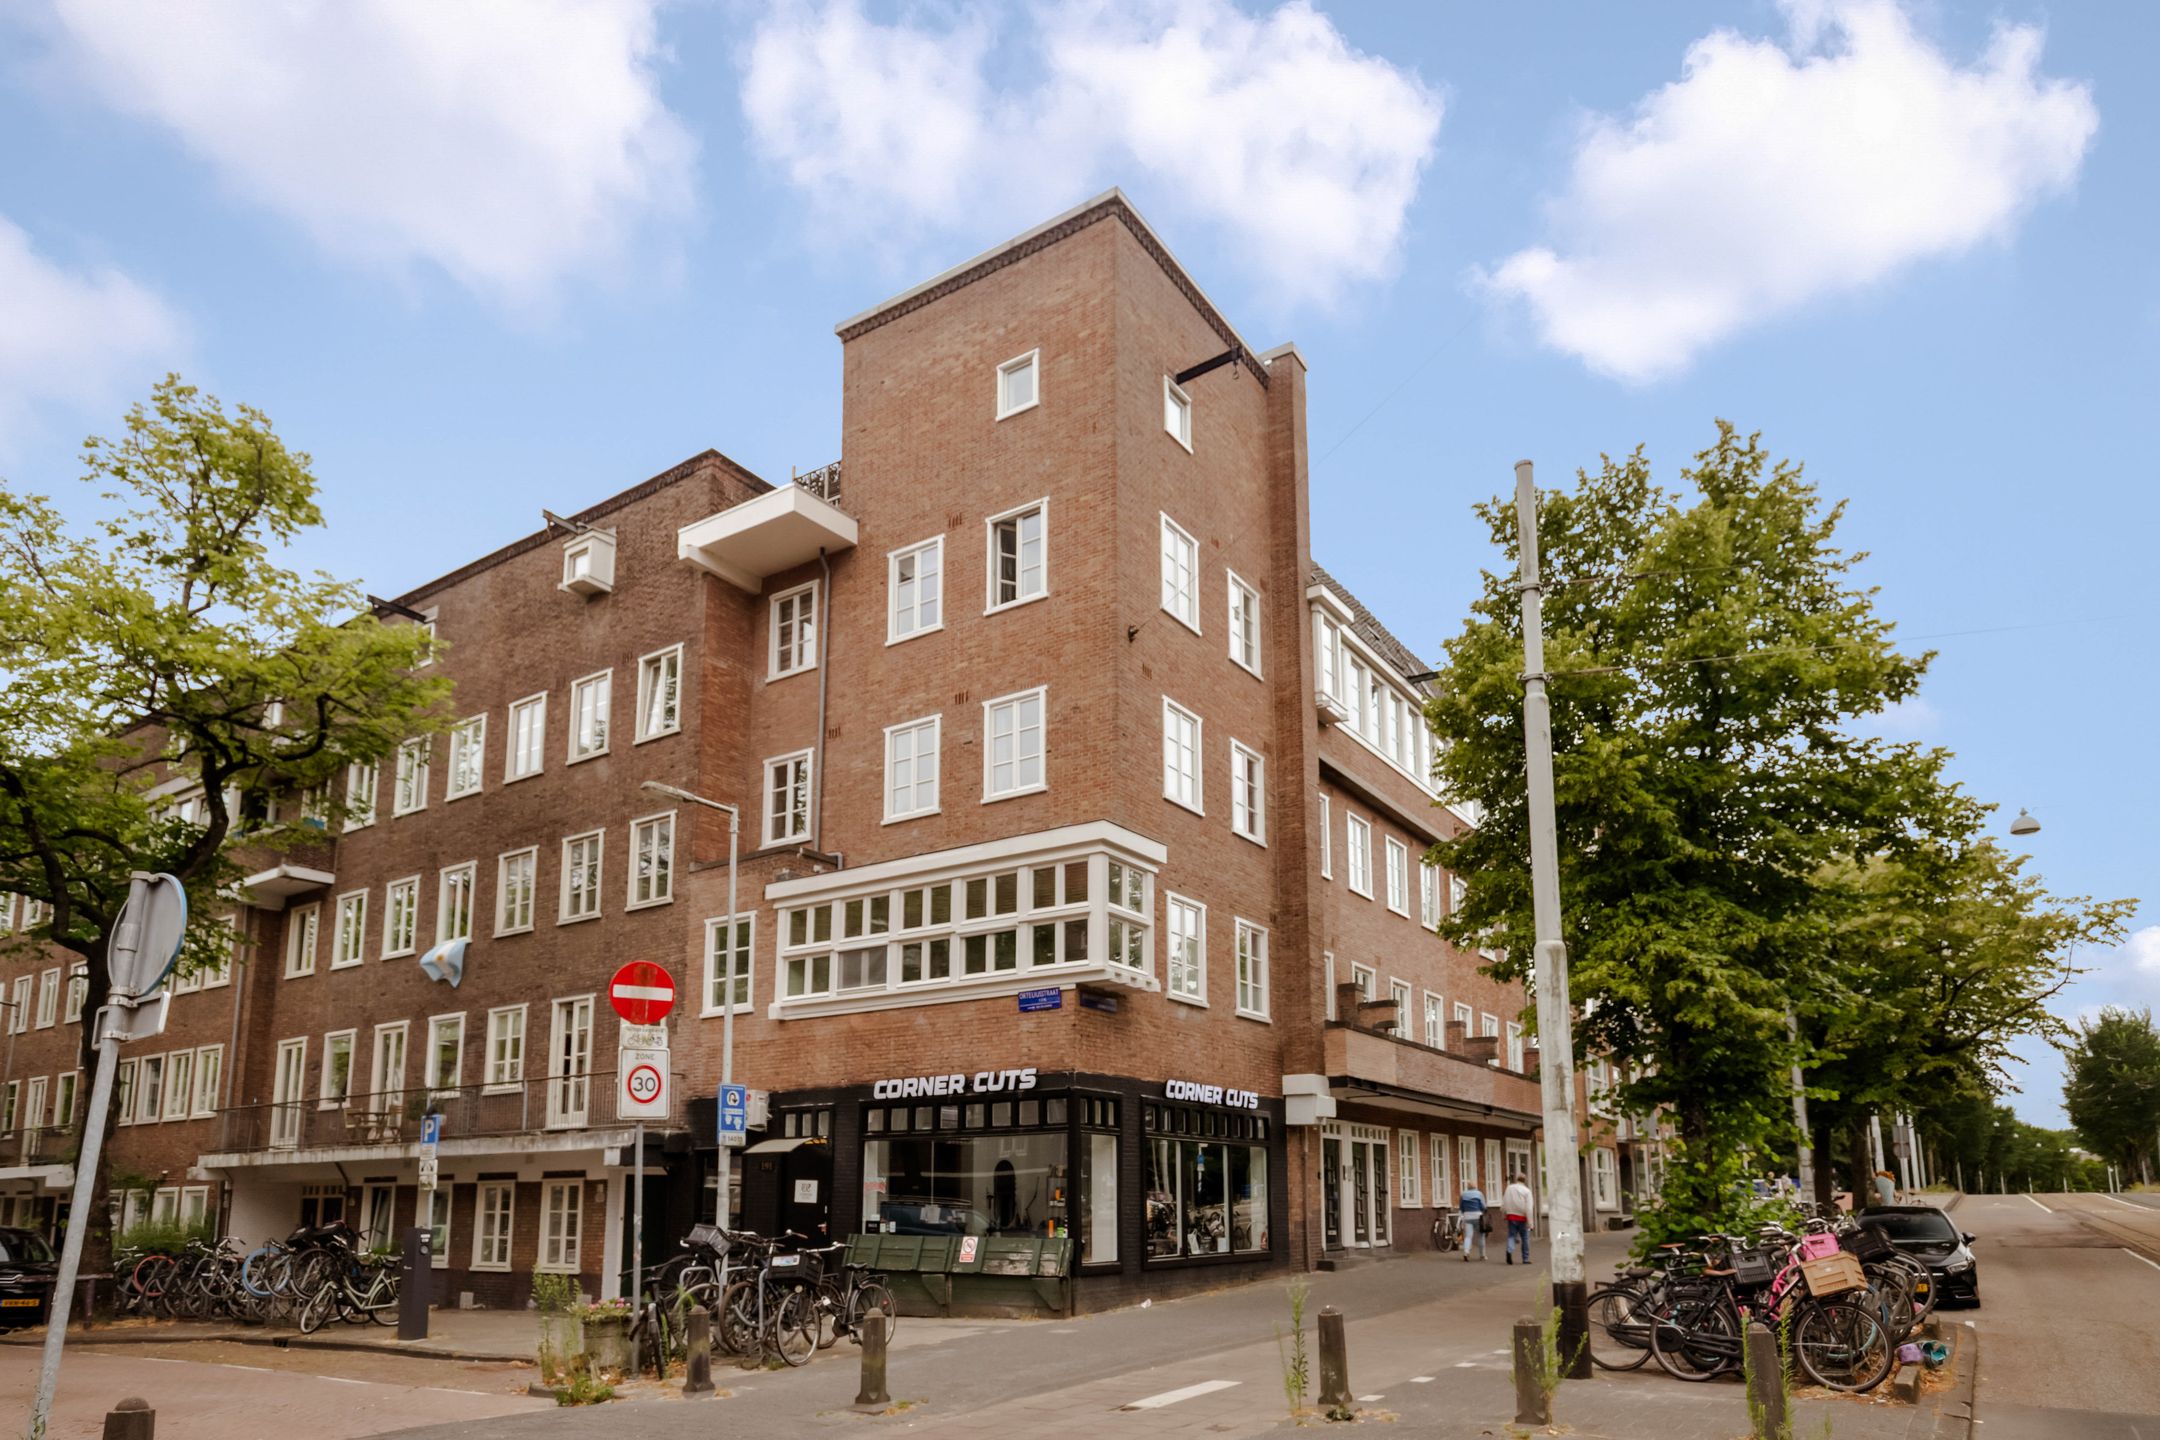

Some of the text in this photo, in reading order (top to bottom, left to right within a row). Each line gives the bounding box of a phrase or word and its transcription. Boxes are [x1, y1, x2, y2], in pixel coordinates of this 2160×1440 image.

[635, 1052, 656, 1060] ZONE
[633, 1076, 656, 1093] 30
[873, 1067, 1037, 1100] CORNER CUTS
[1165, 1079, 1259, 1110] CORNER CUTS
[423, 1119, 435, 1142] P
